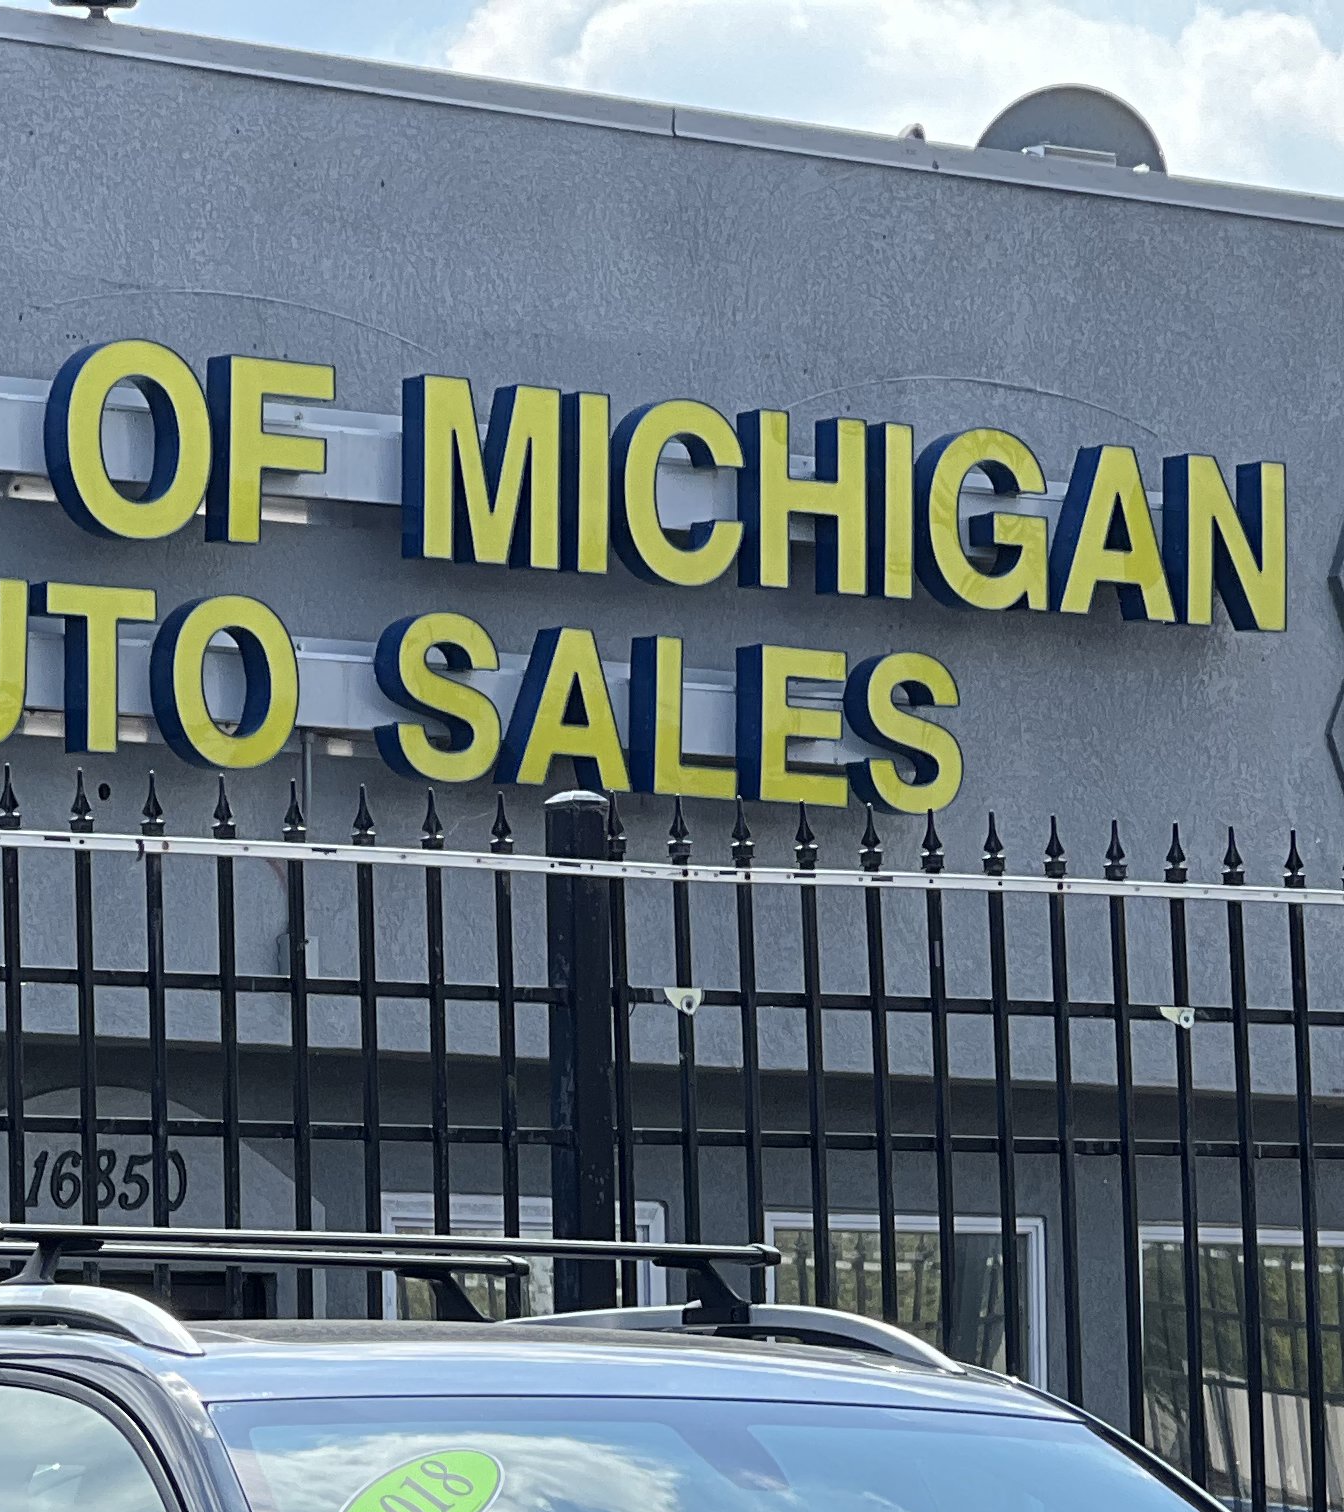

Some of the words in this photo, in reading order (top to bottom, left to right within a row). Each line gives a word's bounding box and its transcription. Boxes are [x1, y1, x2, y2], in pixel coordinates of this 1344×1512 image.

[43, 338, 336, 543] OF
[402, 373, 1287, 632] MICHIGAN
[373, 612, 964, 815] SALES
[24, 1149, 187, 1212] 16850
